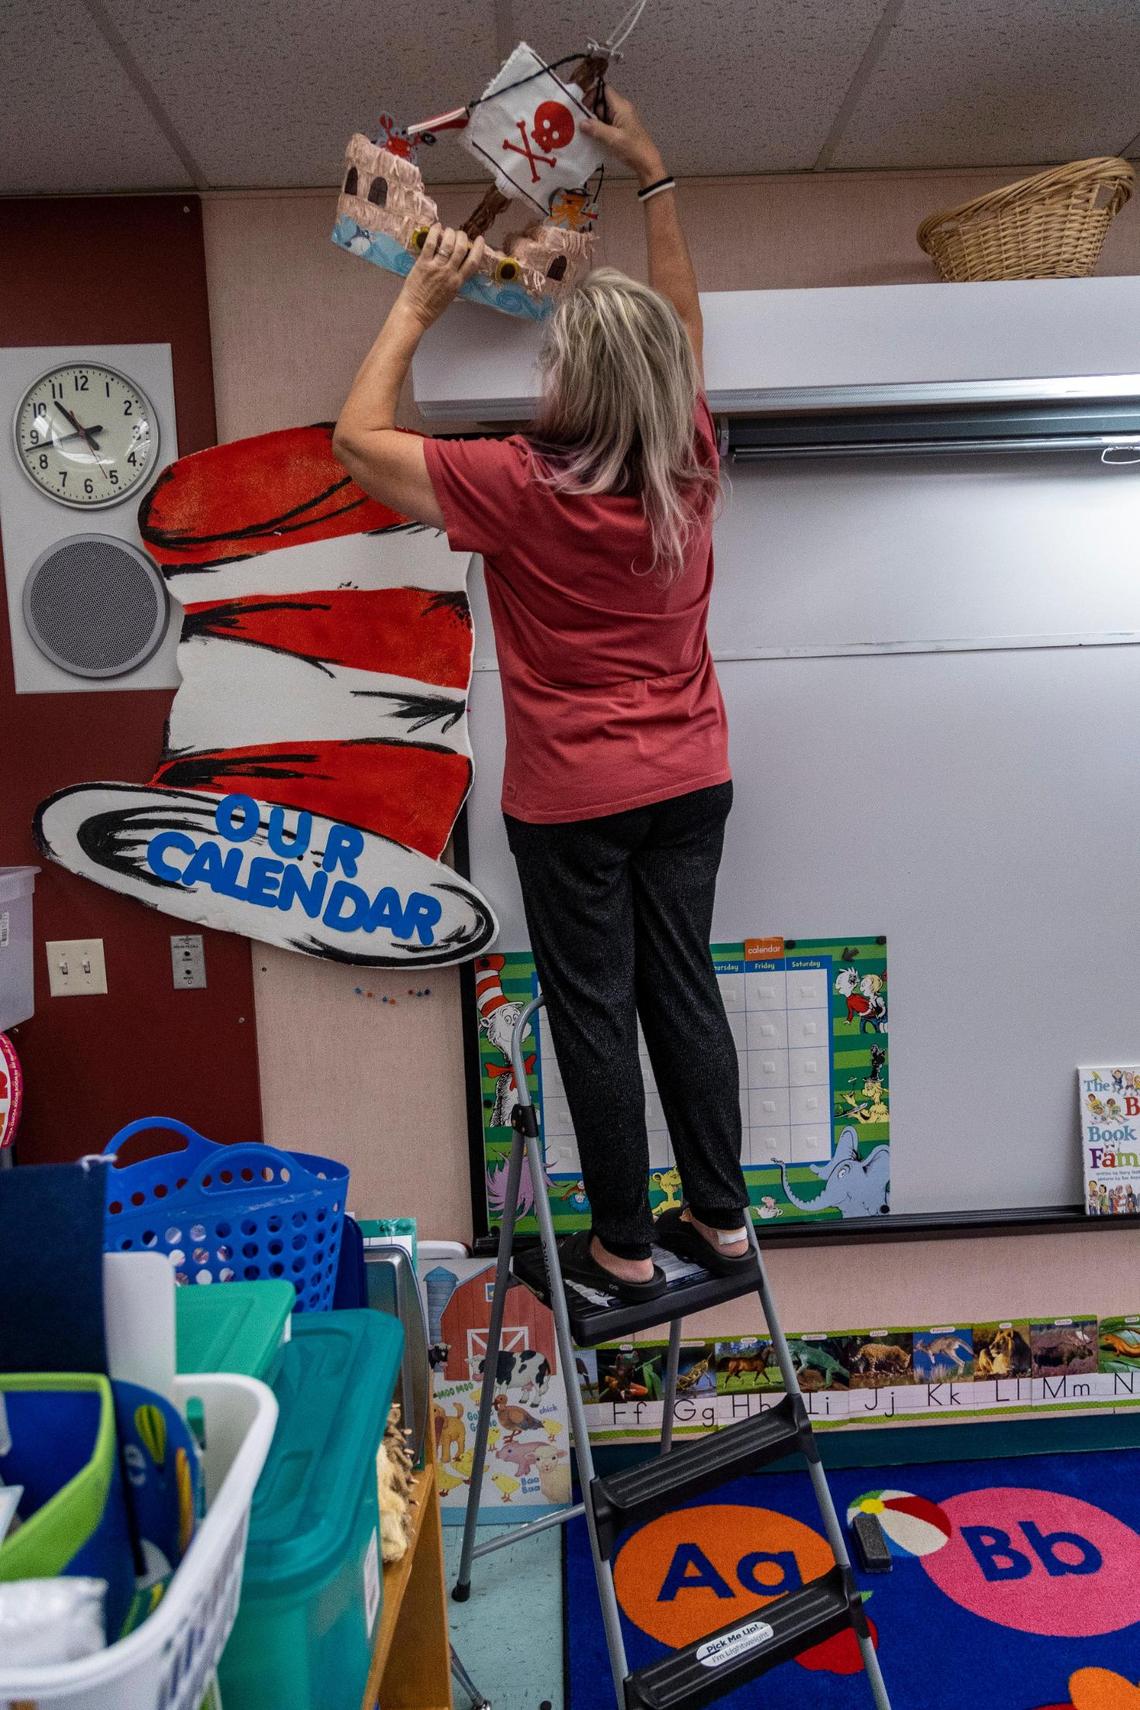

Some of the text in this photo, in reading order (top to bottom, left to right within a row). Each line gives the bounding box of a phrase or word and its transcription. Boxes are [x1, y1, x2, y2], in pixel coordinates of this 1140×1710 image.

[52, 383, 63, 399] 11
[74, 375, 89, 391] 12
[105, 382, 110, 398] 1
[33, 402, 47, 418] 10
[123, 400, 133, 416] 2
[30, 430, 39, 445] 9
[39, 454, 49, 469] 8
[127, 452, 137, 467] 4
[59, 471, 68, 487] 7
[109, 470, 119, 485] 5
[84, 478, 94, 494] 6
[215, 793, 364, 878] OUR
[147, 831, 442, 946] CALENDAR
[748, 945, 781, 955] calendar
[755, 962, 775, 970] Friday
[791, 960, 821, 969] Saturday
[1084, 1080, 1110, 1092] The
[1087, 1125, 1137, 1142] Book
[1114, 1372, 1134, 1394] N
[959, 1520, 1103, 1582] Bb
[656, 1542, 805, 1602] Aa
[706, 1624, 759, 1653] Pick Me Up!
[711, 1631, 770, 1663] I'm Lightweight
